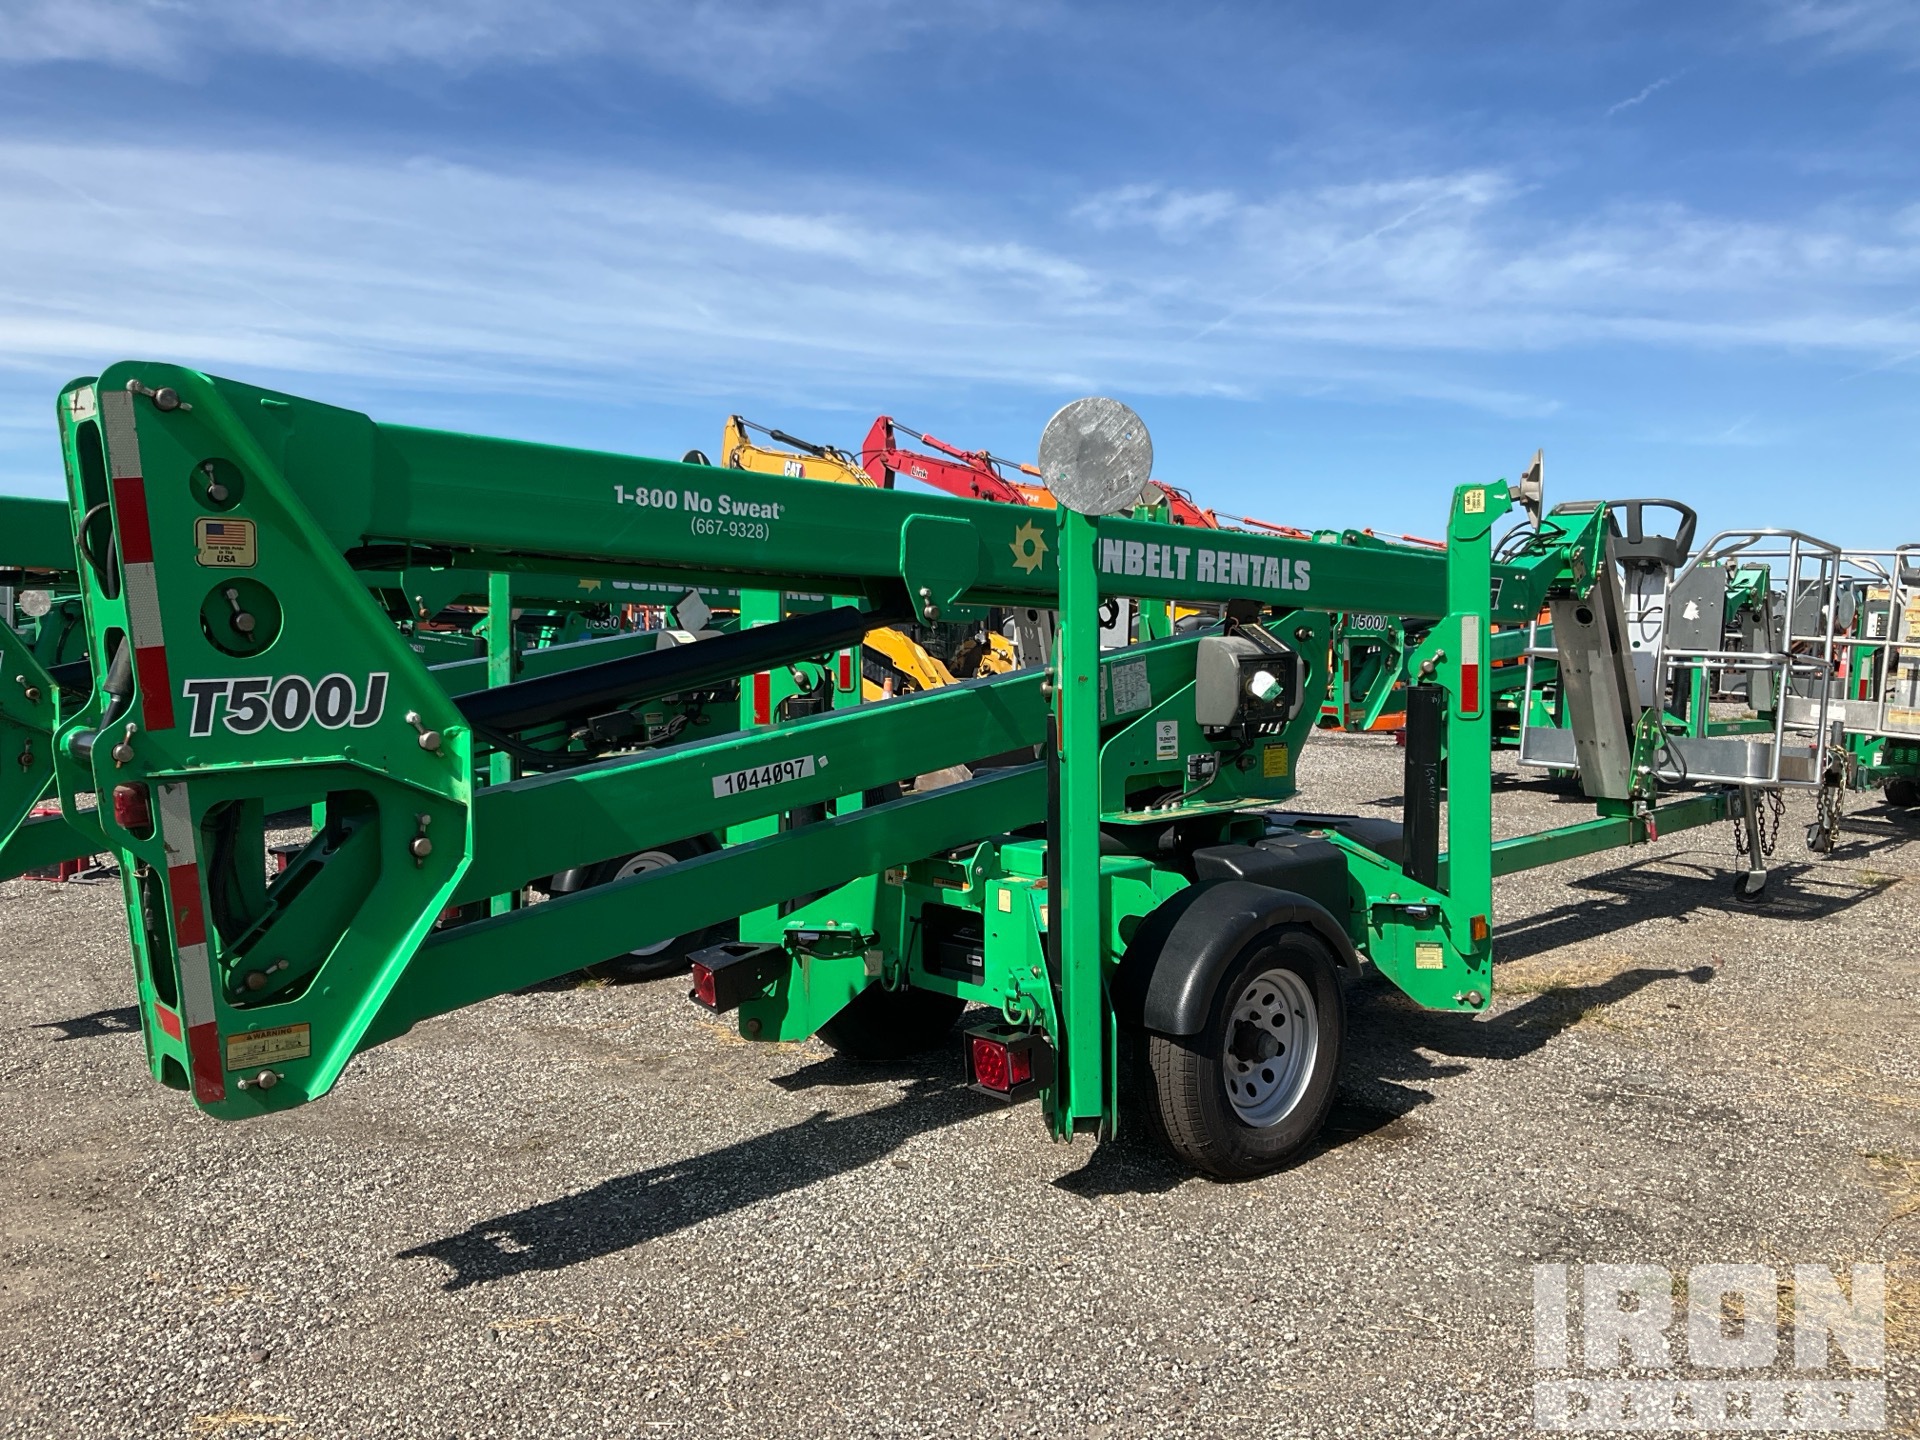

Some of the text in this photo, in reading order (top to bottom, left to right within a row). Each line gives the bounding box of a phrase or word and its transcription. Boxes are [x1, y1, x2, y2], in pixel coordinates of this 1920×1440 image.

[784, 461, 803, 478] CAT
[614, 485, 678, 510] 1-800
[683, 491, 713, 513] No
[690, 515, 770, 542] (667-9328)
[216, 555, 236, 563] USA
[1098, 537, 1312, 592] NBELT RENTALS
[1351, 613, 1388, 631] T500J
[182, 672, 390, 738] T500J
[724, 758, 806, 794] 1044097
[253, 1027, 293, 1040] WARNING
